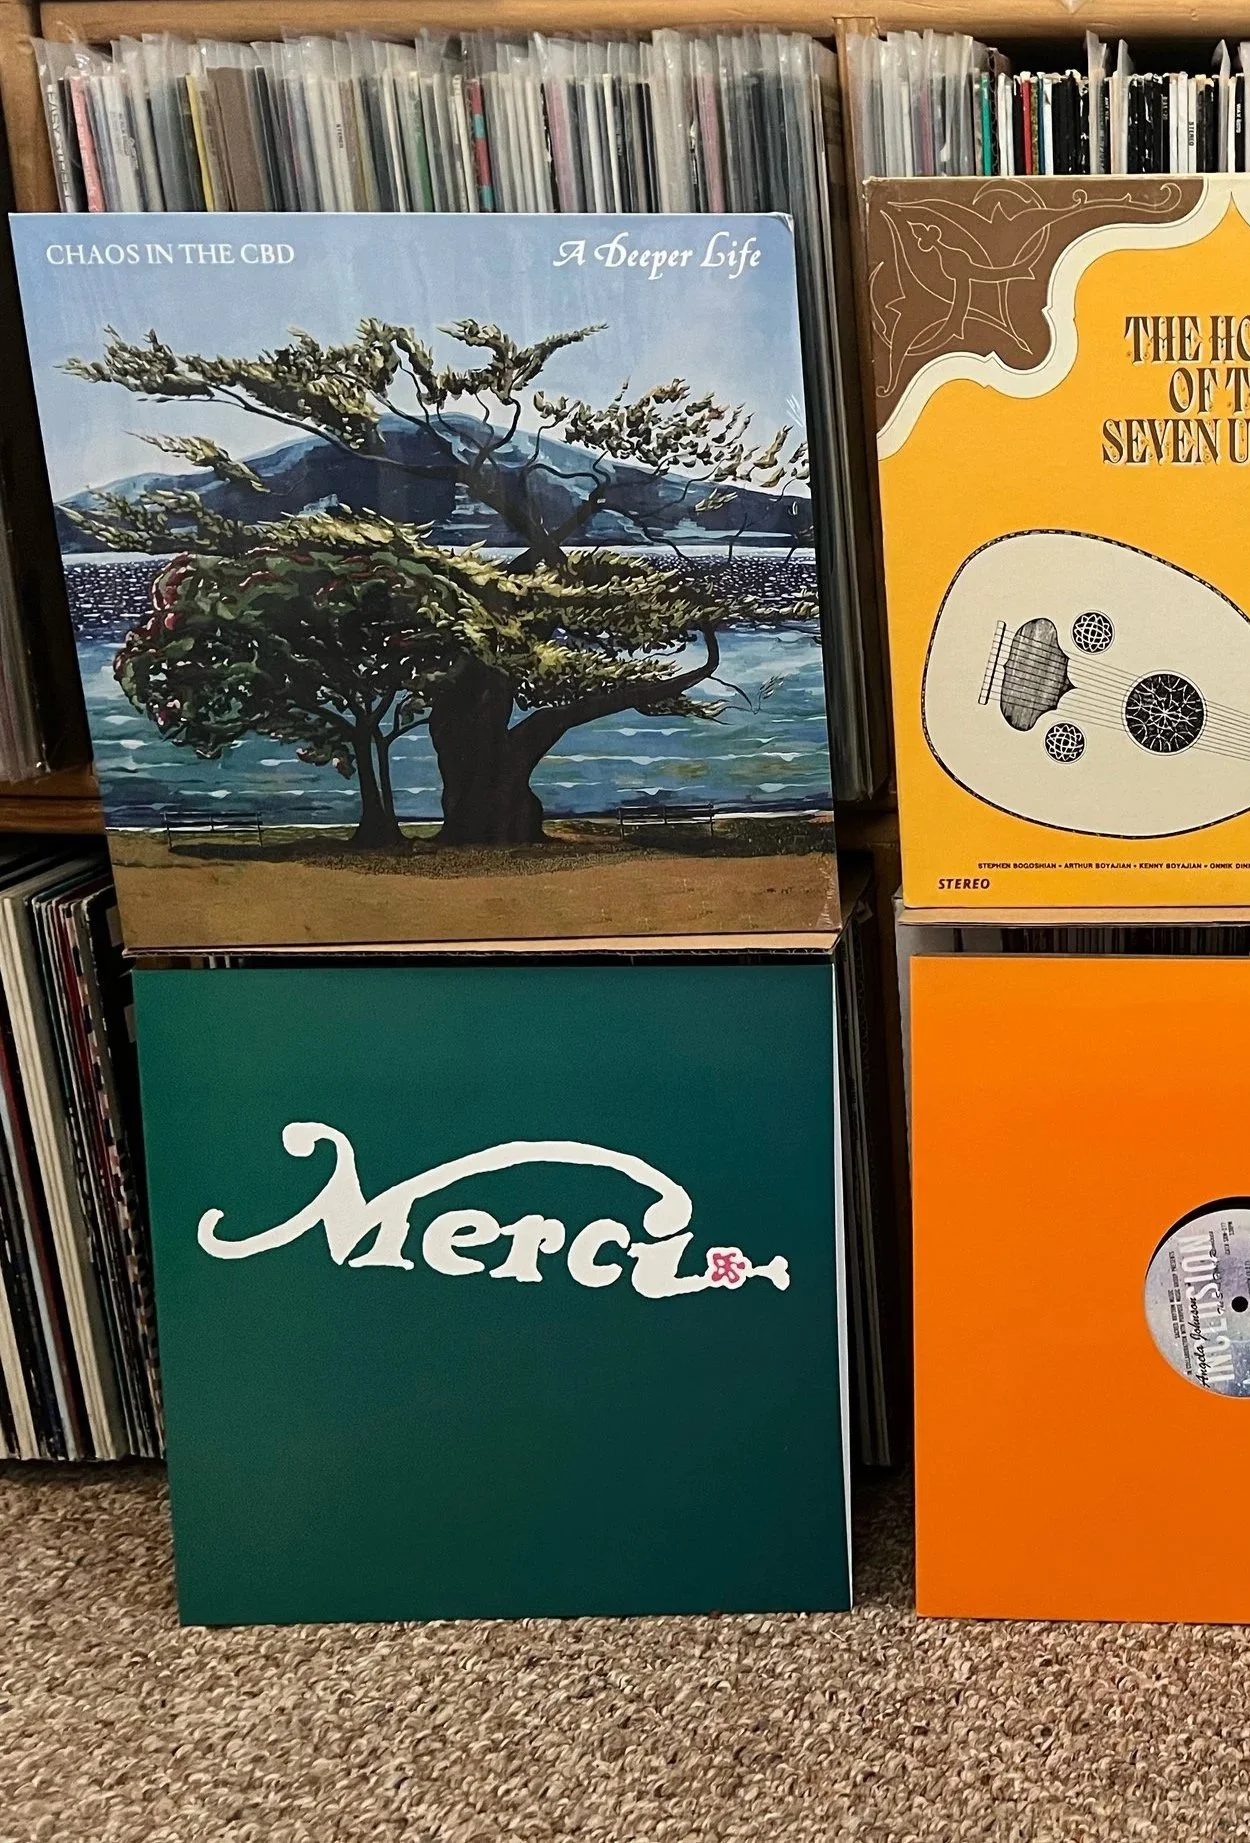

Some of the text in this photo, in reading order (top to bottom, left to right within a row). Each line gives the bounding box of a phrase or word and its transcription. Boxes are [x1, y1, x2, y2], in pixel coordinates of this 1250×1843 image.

[46, 244, 295, 265] CHAOS IN THE CBD
[552, 231, 762, 280] A Deeper Life
[1123, 314, 1203, 365] THE
[1168, 366, 1219, 415] OF
[1102, 418, 1222, 466] SEVEN
[938, 878, 991, 890] STEREO
[197, 1121, 790, 1299] Merci
[1176, 1234, 1236, 1384] INCLUSION
[1188, 1297, 1212, 1388] Angela Johnson
